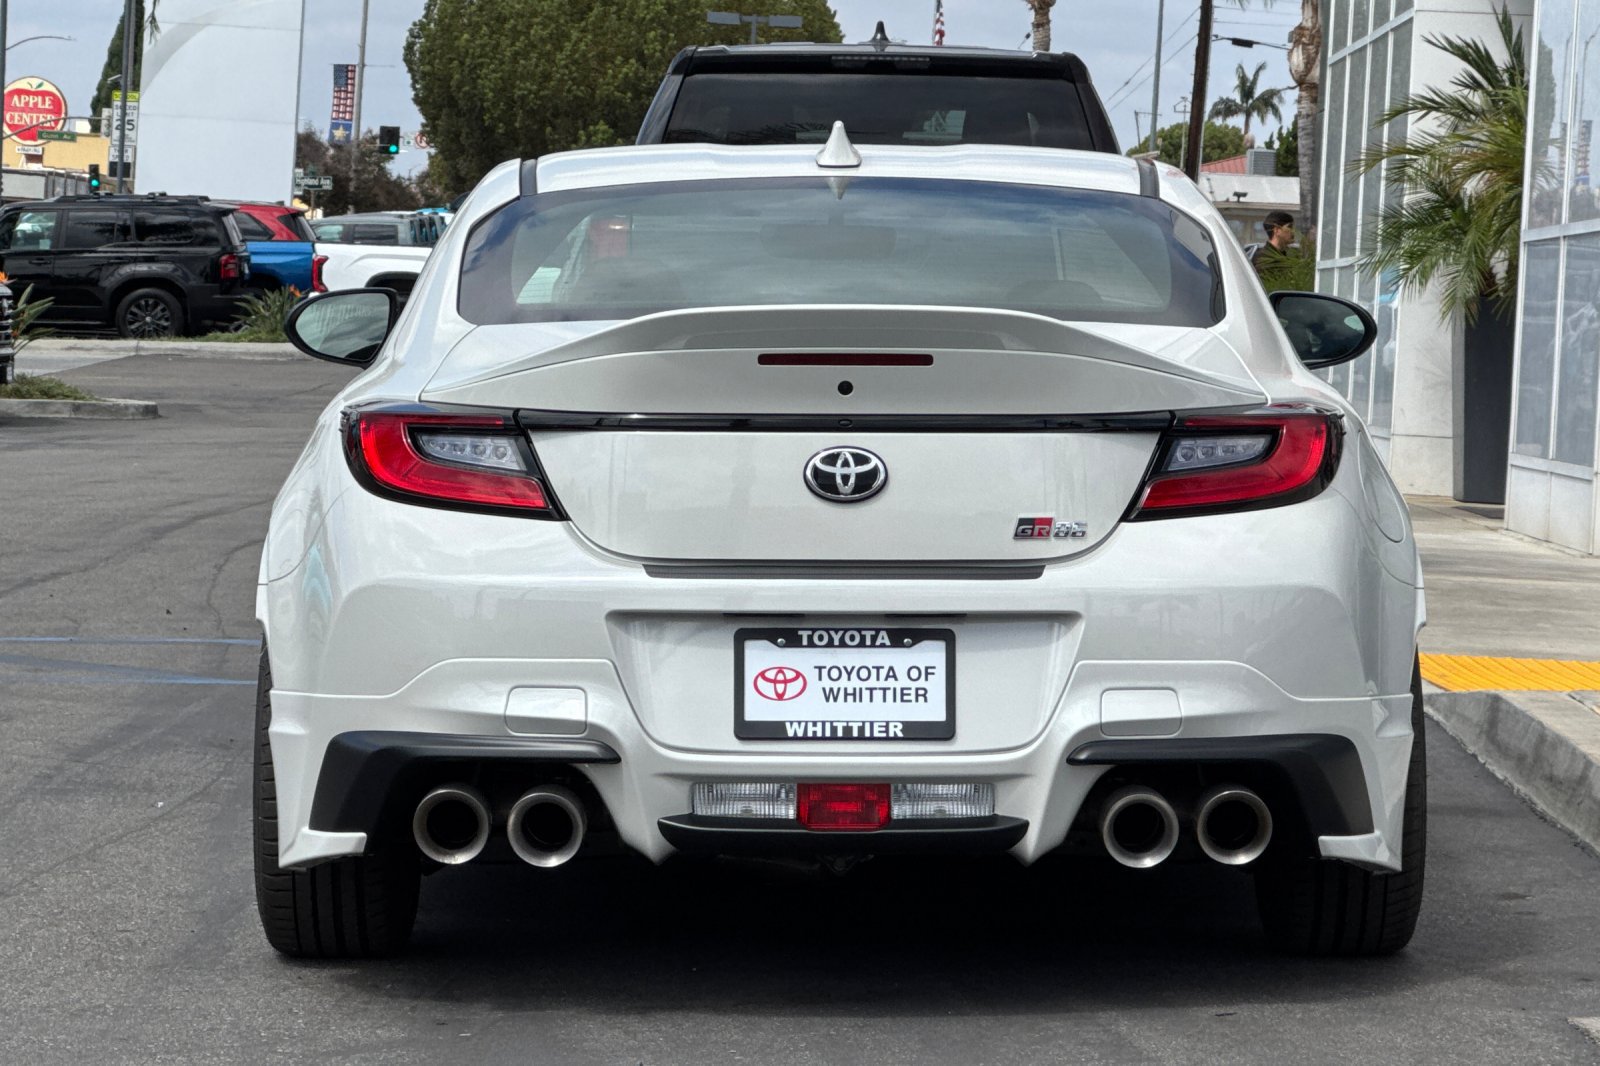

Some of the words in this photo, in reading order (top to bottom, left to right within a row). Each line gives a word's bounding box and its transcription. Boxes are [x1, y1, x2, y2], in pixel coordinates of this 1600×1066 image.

[11, 94, 54, 109] APPLE
[5, 111, 56, 127] CENTER
[115, 118, 135, 131] 25
[1016, 525, 1051, 537] GR
[798, 630, 891, 646] TOYOTA
[814, 665, 899, 682] TOYOTA
[906, 665, 937, 682] OF
[822, 687, 929, 703] WHITTIER
[785, 721, 904, 738] WHITTIER
